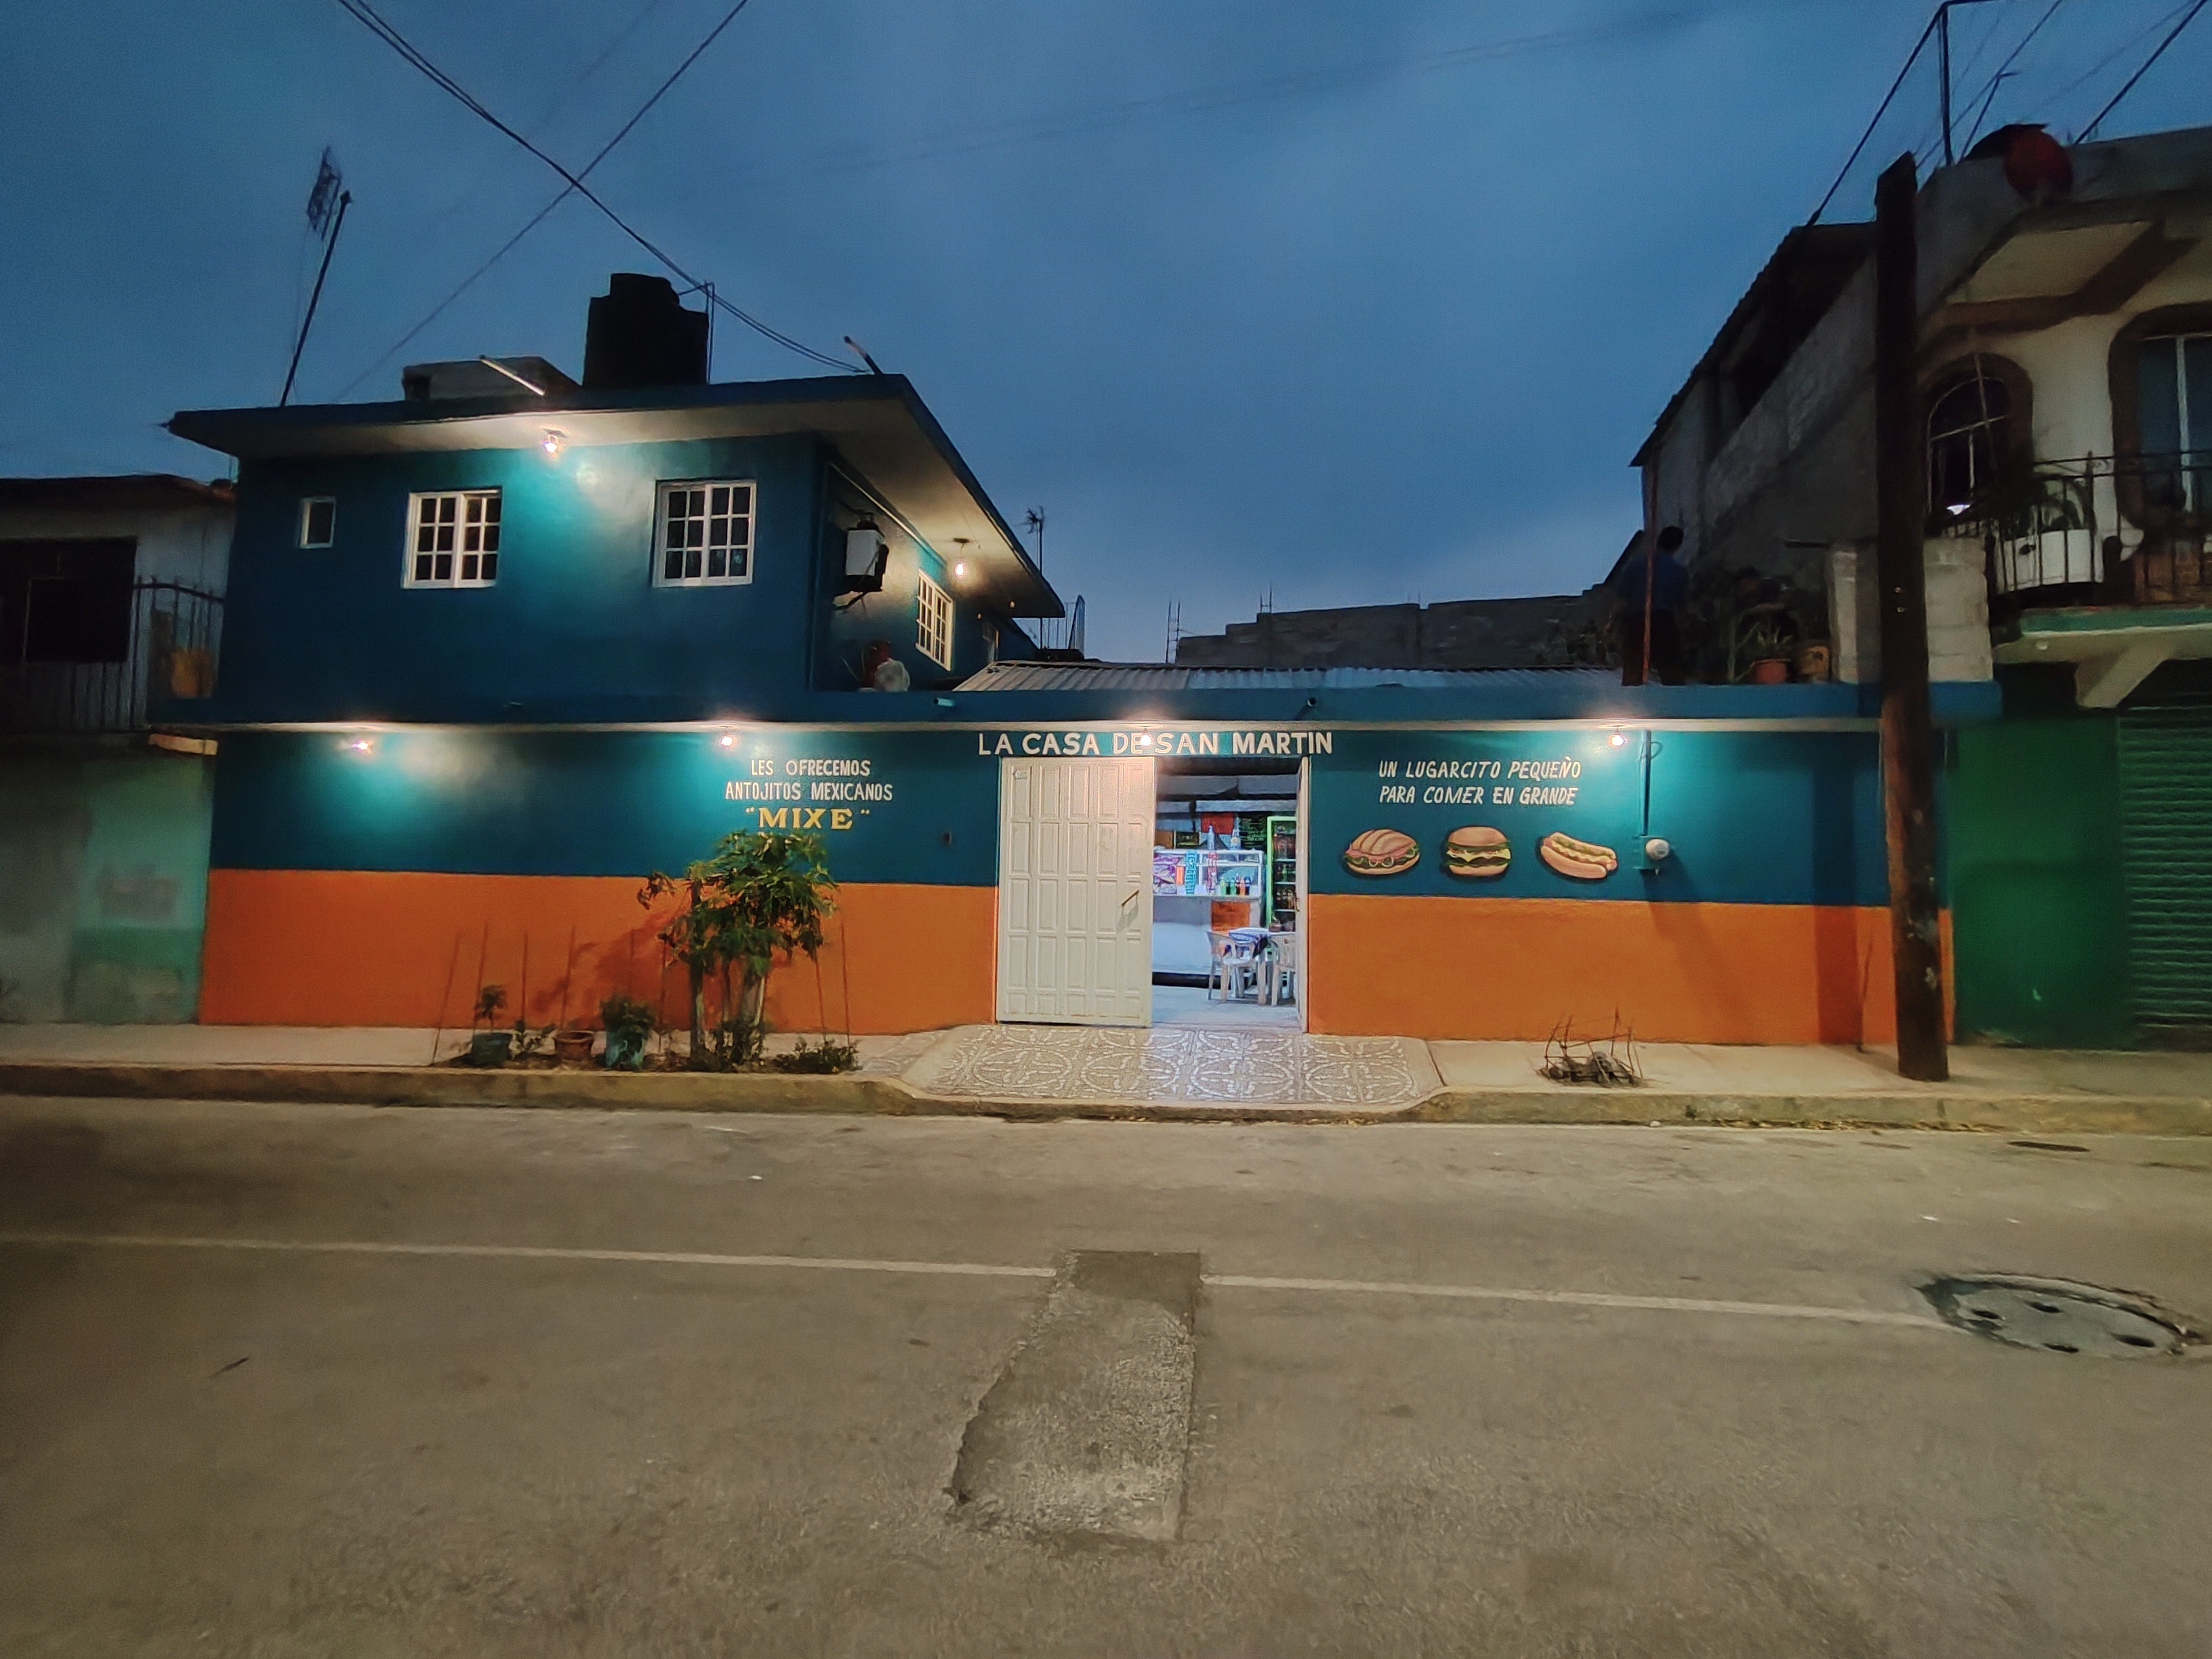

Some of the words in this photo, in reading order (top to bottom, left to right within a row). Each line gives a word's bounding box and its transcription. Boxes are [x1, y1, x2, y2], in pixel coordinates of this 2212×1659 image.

[978, 733, 1013, 756] LA
[1022, 732, 1100, 756] CASA
[1113, 733, 1144, 754] DE
[1154, 733, 1218, 754] SAN
[1232, 731, 1332, 754] MARTIN
[750, 759, 775, 776] LES
[785, 758, 871, 777] OFRECEMOS
[1379, 760, 1398, 778] UN
[1405, 760, 1502, 779] LUGARCITO
[724, 781, 802, 801] ANTOJITOS
[811, 782, 893, 801] MEXICANOS
[1379, 785, 1416, 804] PARA
[1423, 786, 1485, 804] COMER
[1492, 787, 1515, 804] EN
[1519, 787, 1579, 805] GRANDE
